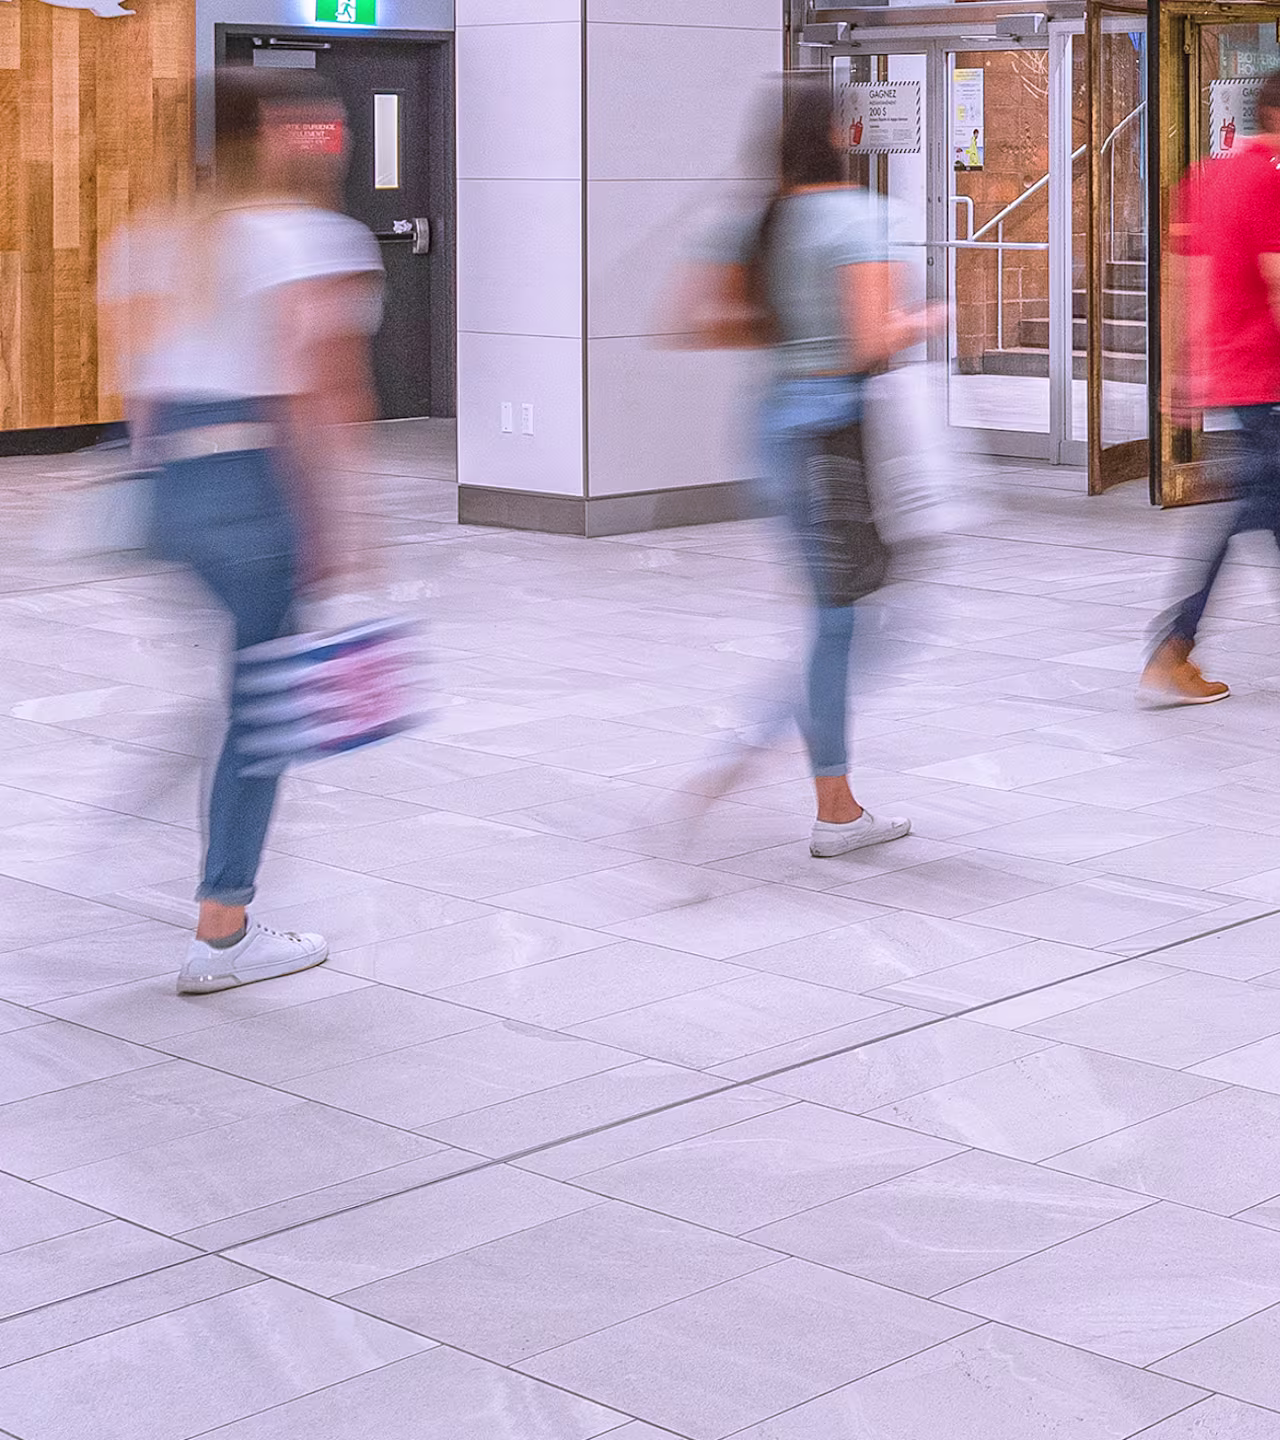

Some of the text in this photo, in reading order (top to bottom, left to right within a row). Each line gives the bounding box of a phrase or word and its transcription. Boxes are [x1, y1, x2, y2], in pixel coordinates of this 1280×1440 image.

[869, 89, 897, 99] GAGNEZ
[869, 106, 887, 117] 200 $
